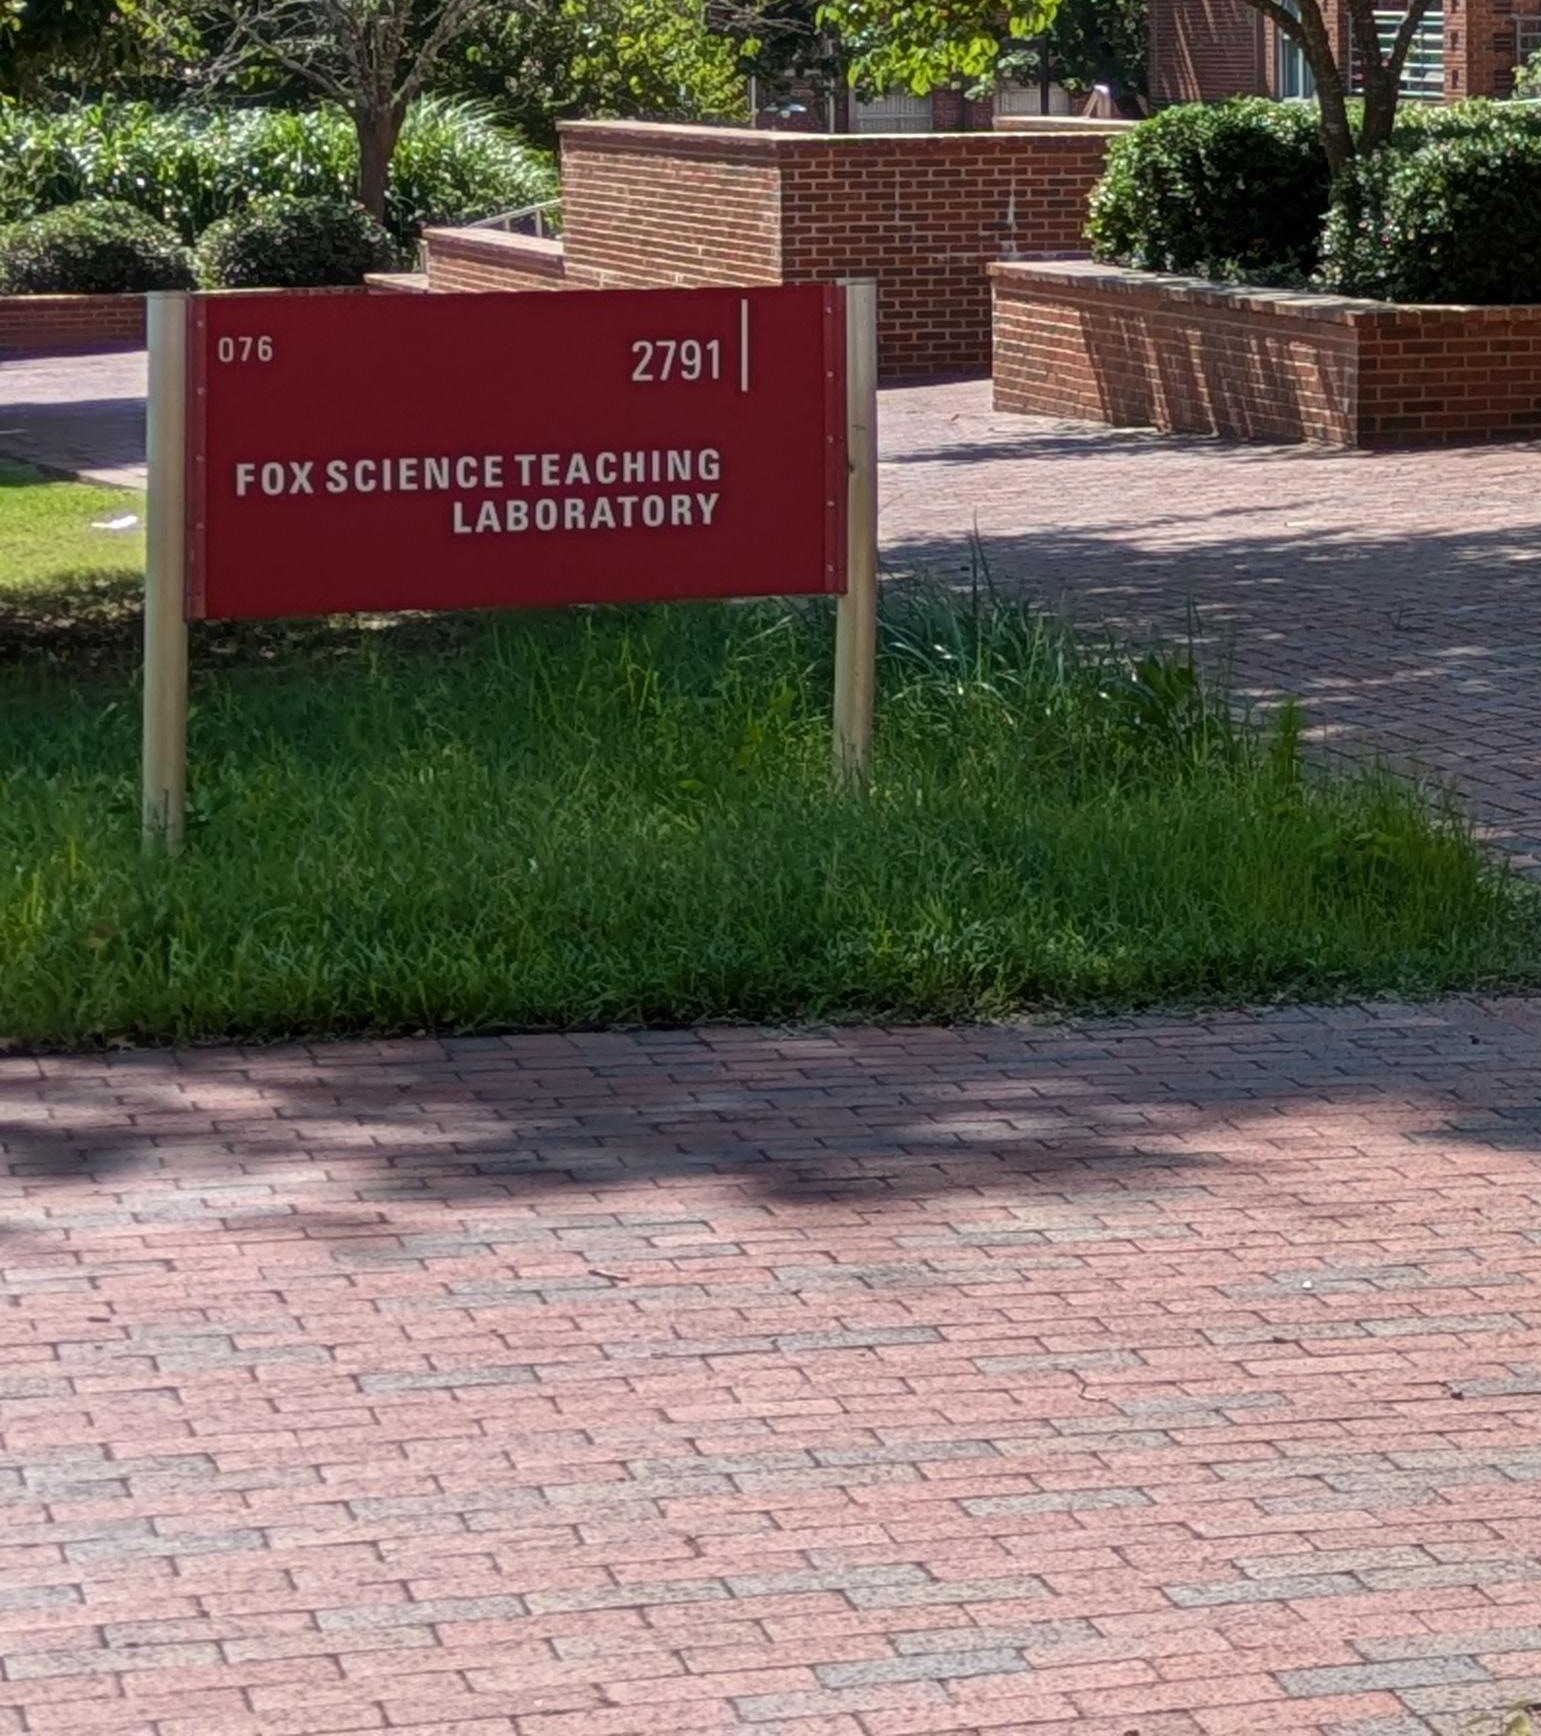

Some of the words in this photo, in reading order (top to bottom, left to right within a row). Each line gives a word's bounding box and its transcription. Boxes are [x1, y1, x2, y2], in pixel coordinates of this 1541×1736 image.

[217, 335, 273, 363] 076
[632, 339, 720, 382] 2791
[236, 461, 315, 497] FOX
[326, 455, 505, 493] SCIENCE
[515, 448, 721, 486] TEACHING
[453, 493, 720, 534] LABORATORY
